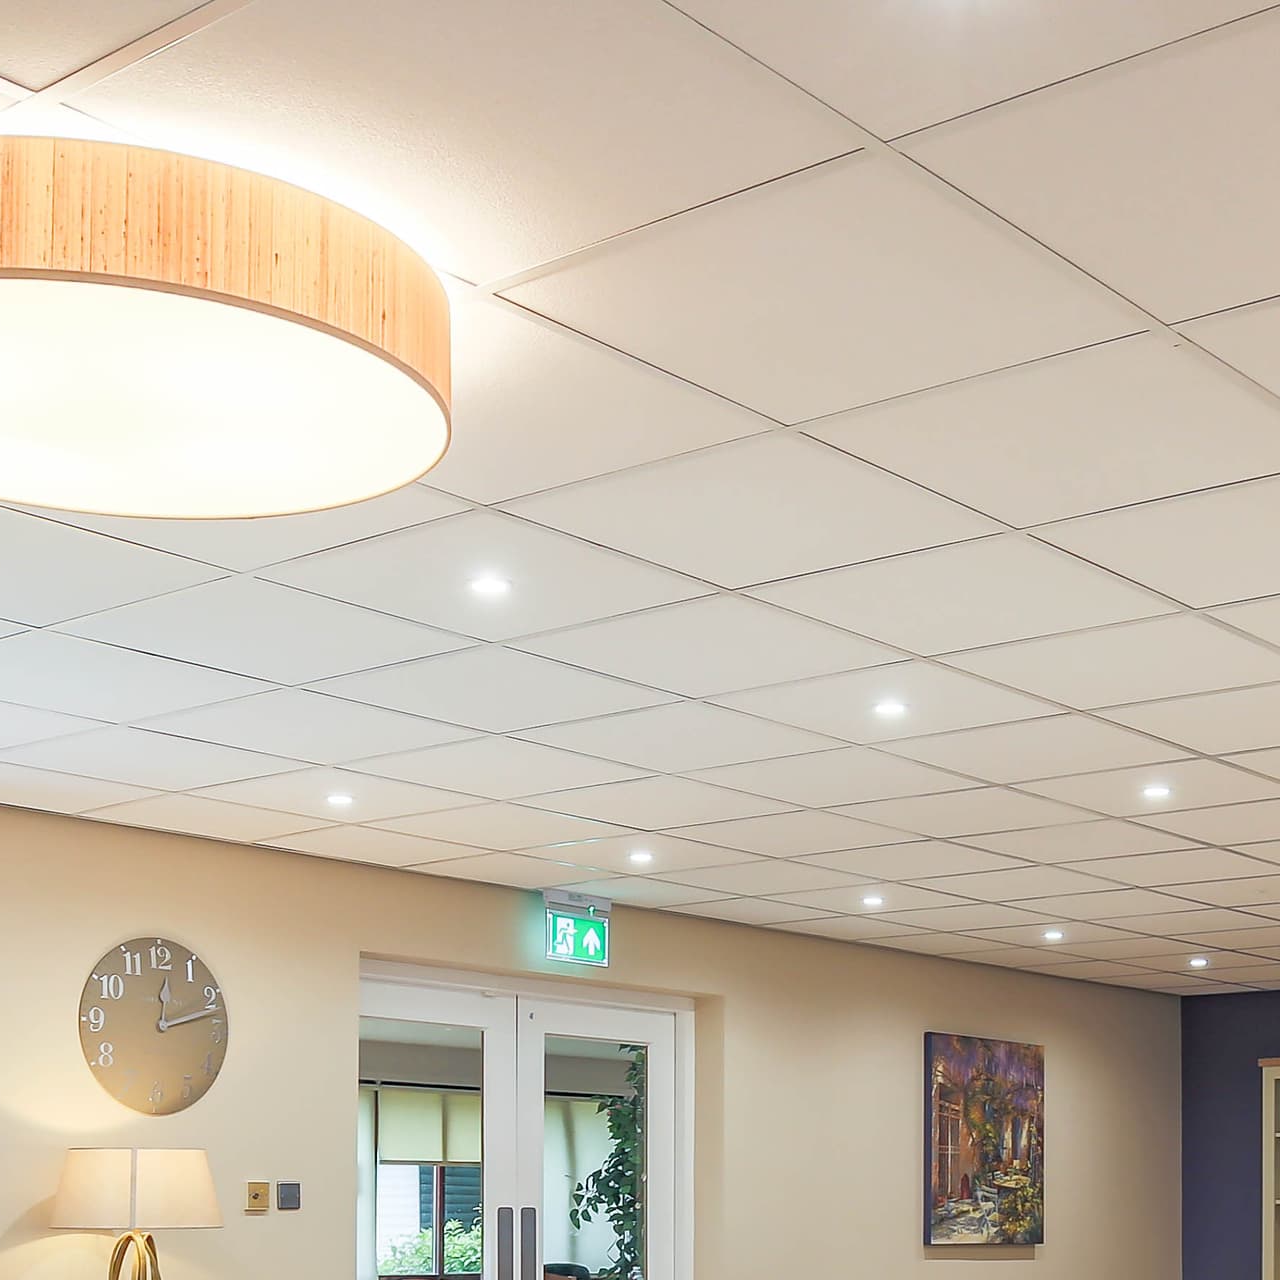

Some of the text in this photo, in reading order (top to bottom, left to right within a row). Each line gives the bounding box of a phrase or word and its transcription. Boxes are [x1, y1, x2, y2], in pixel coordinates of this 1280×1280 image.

[123, 950, 142, 976] 11
[148, 945, 172, 971] 12
[185, 958, 195, 983] 1
[99, 974, 124, 1000] 10
[203, 986, 218, 1009] 2
[88, 1006, 105, 1033] 9
[98, 1041, 114, 1067] 8
